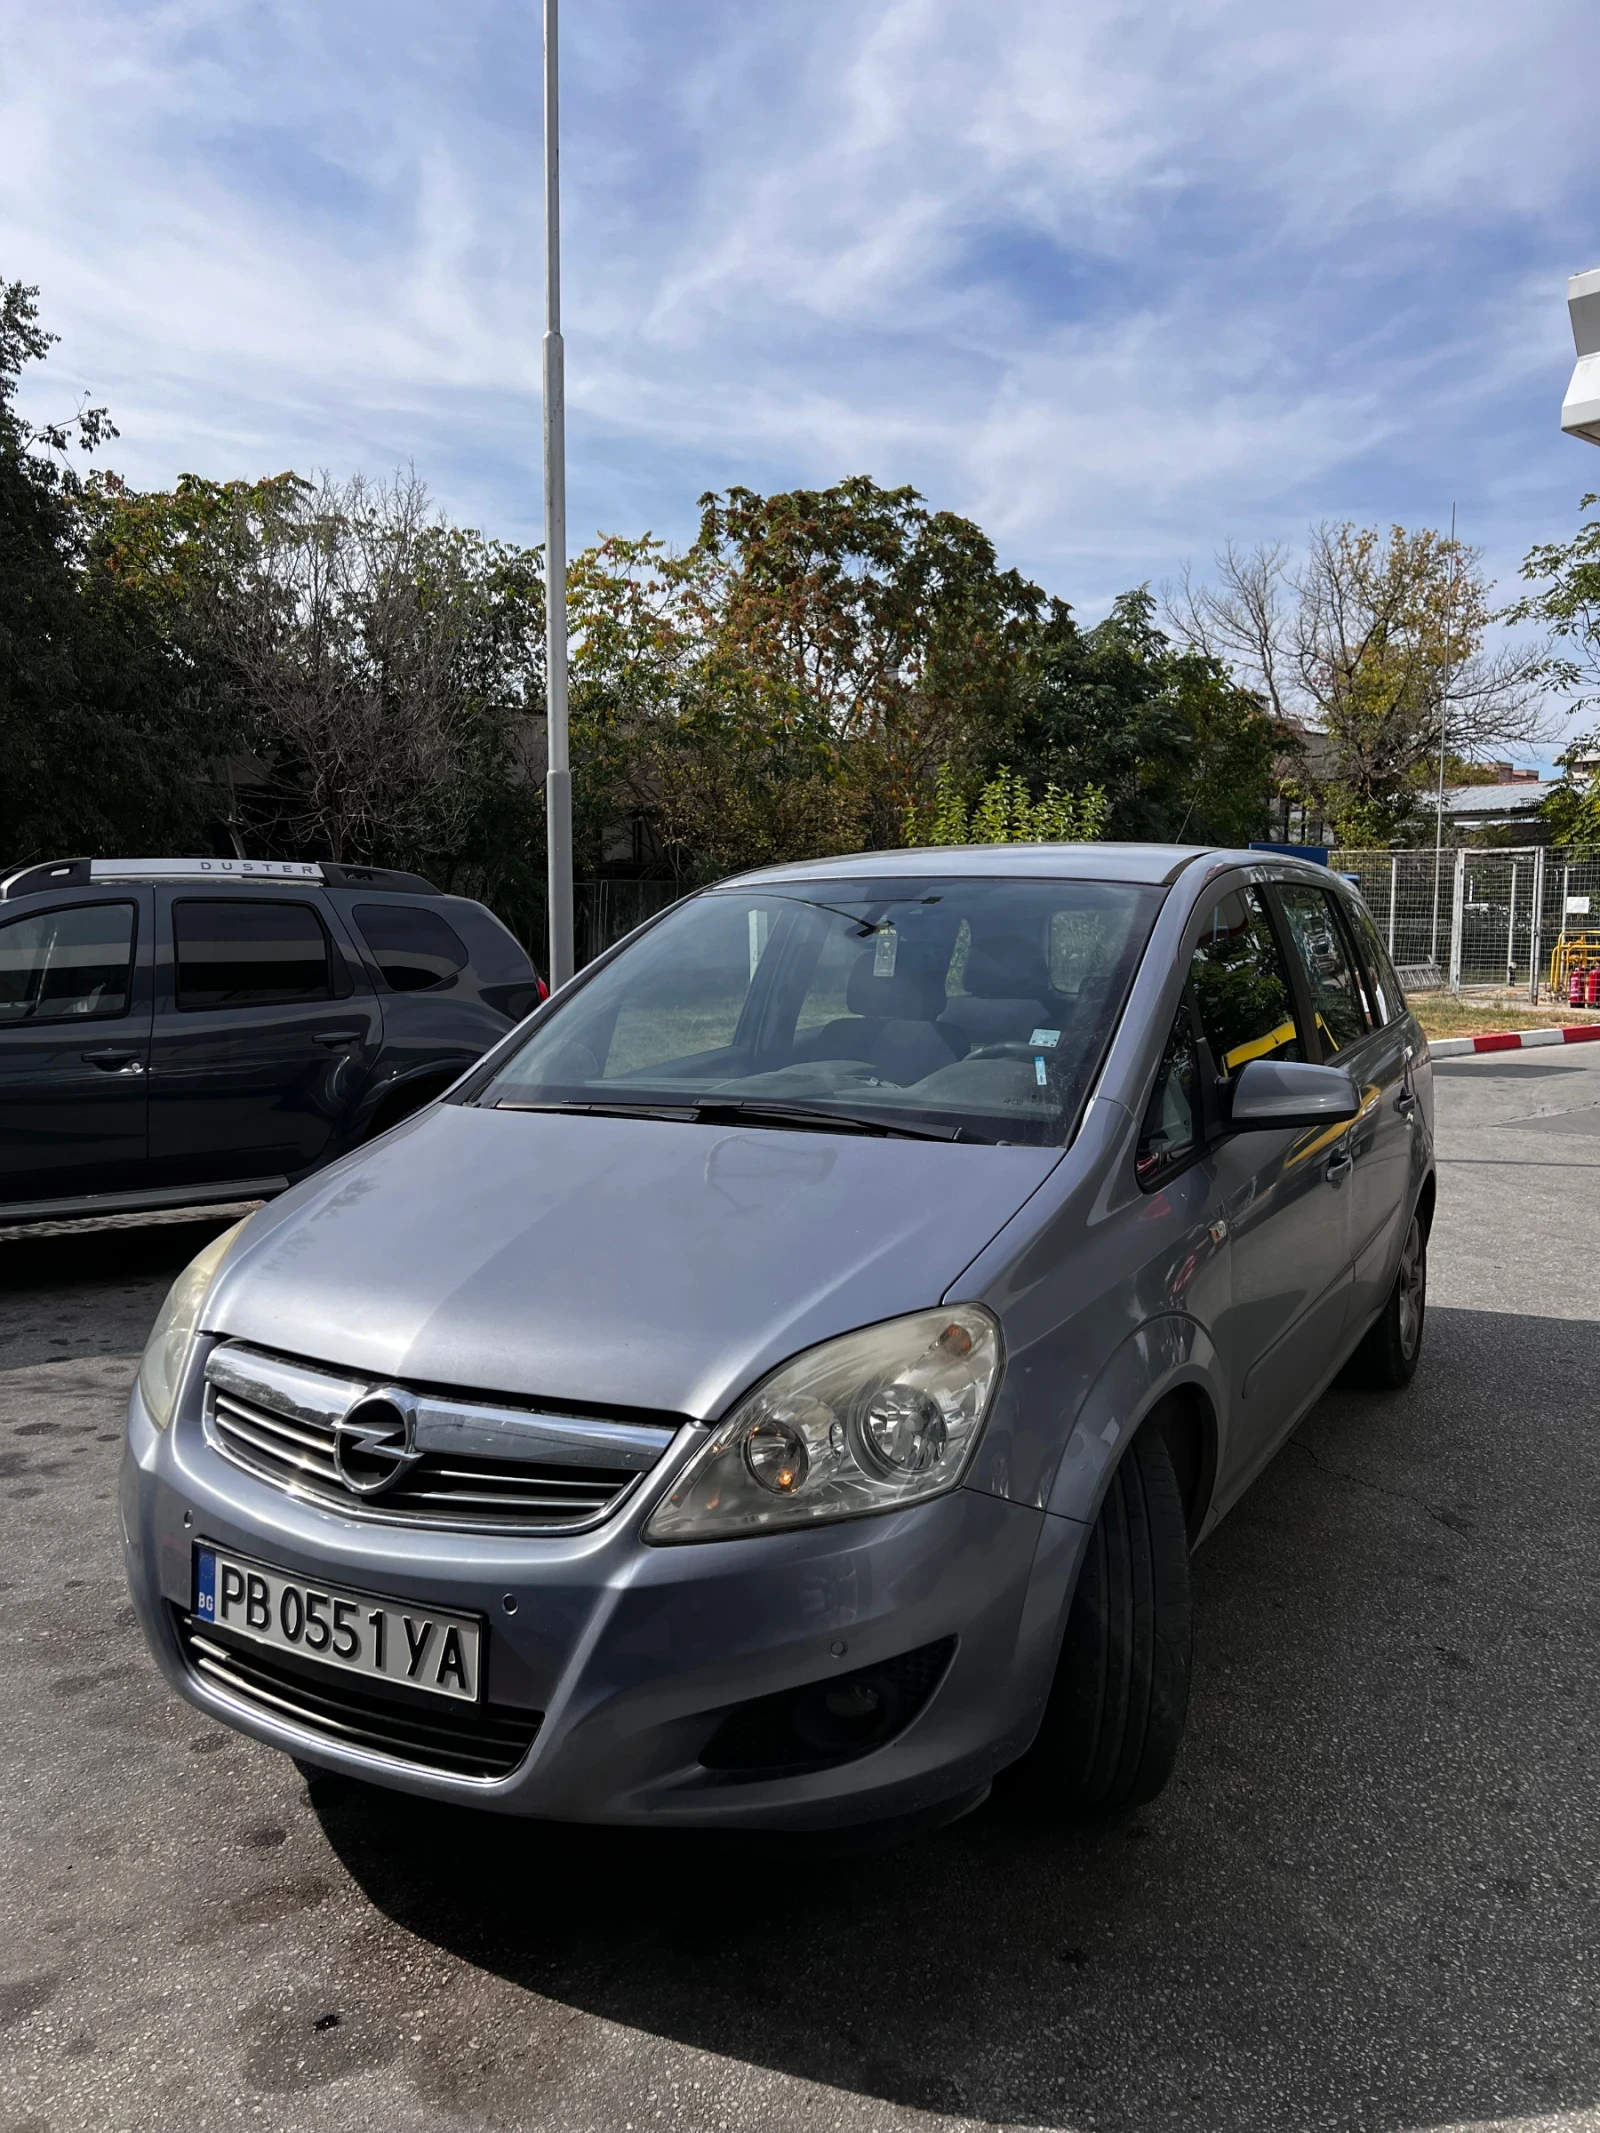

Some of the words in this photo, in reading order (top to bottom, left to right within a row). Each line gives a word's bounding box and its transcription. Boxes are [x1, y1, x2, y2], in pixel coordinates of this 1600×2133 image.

[201, 862, 313, 874] DUSTER
[198, 1591, 214, 1612] BG
[221, 1564, 269, 1630] PB
[280, 1584, 384, 1668] 0551
[402, 1615, 467, 1690] YA
